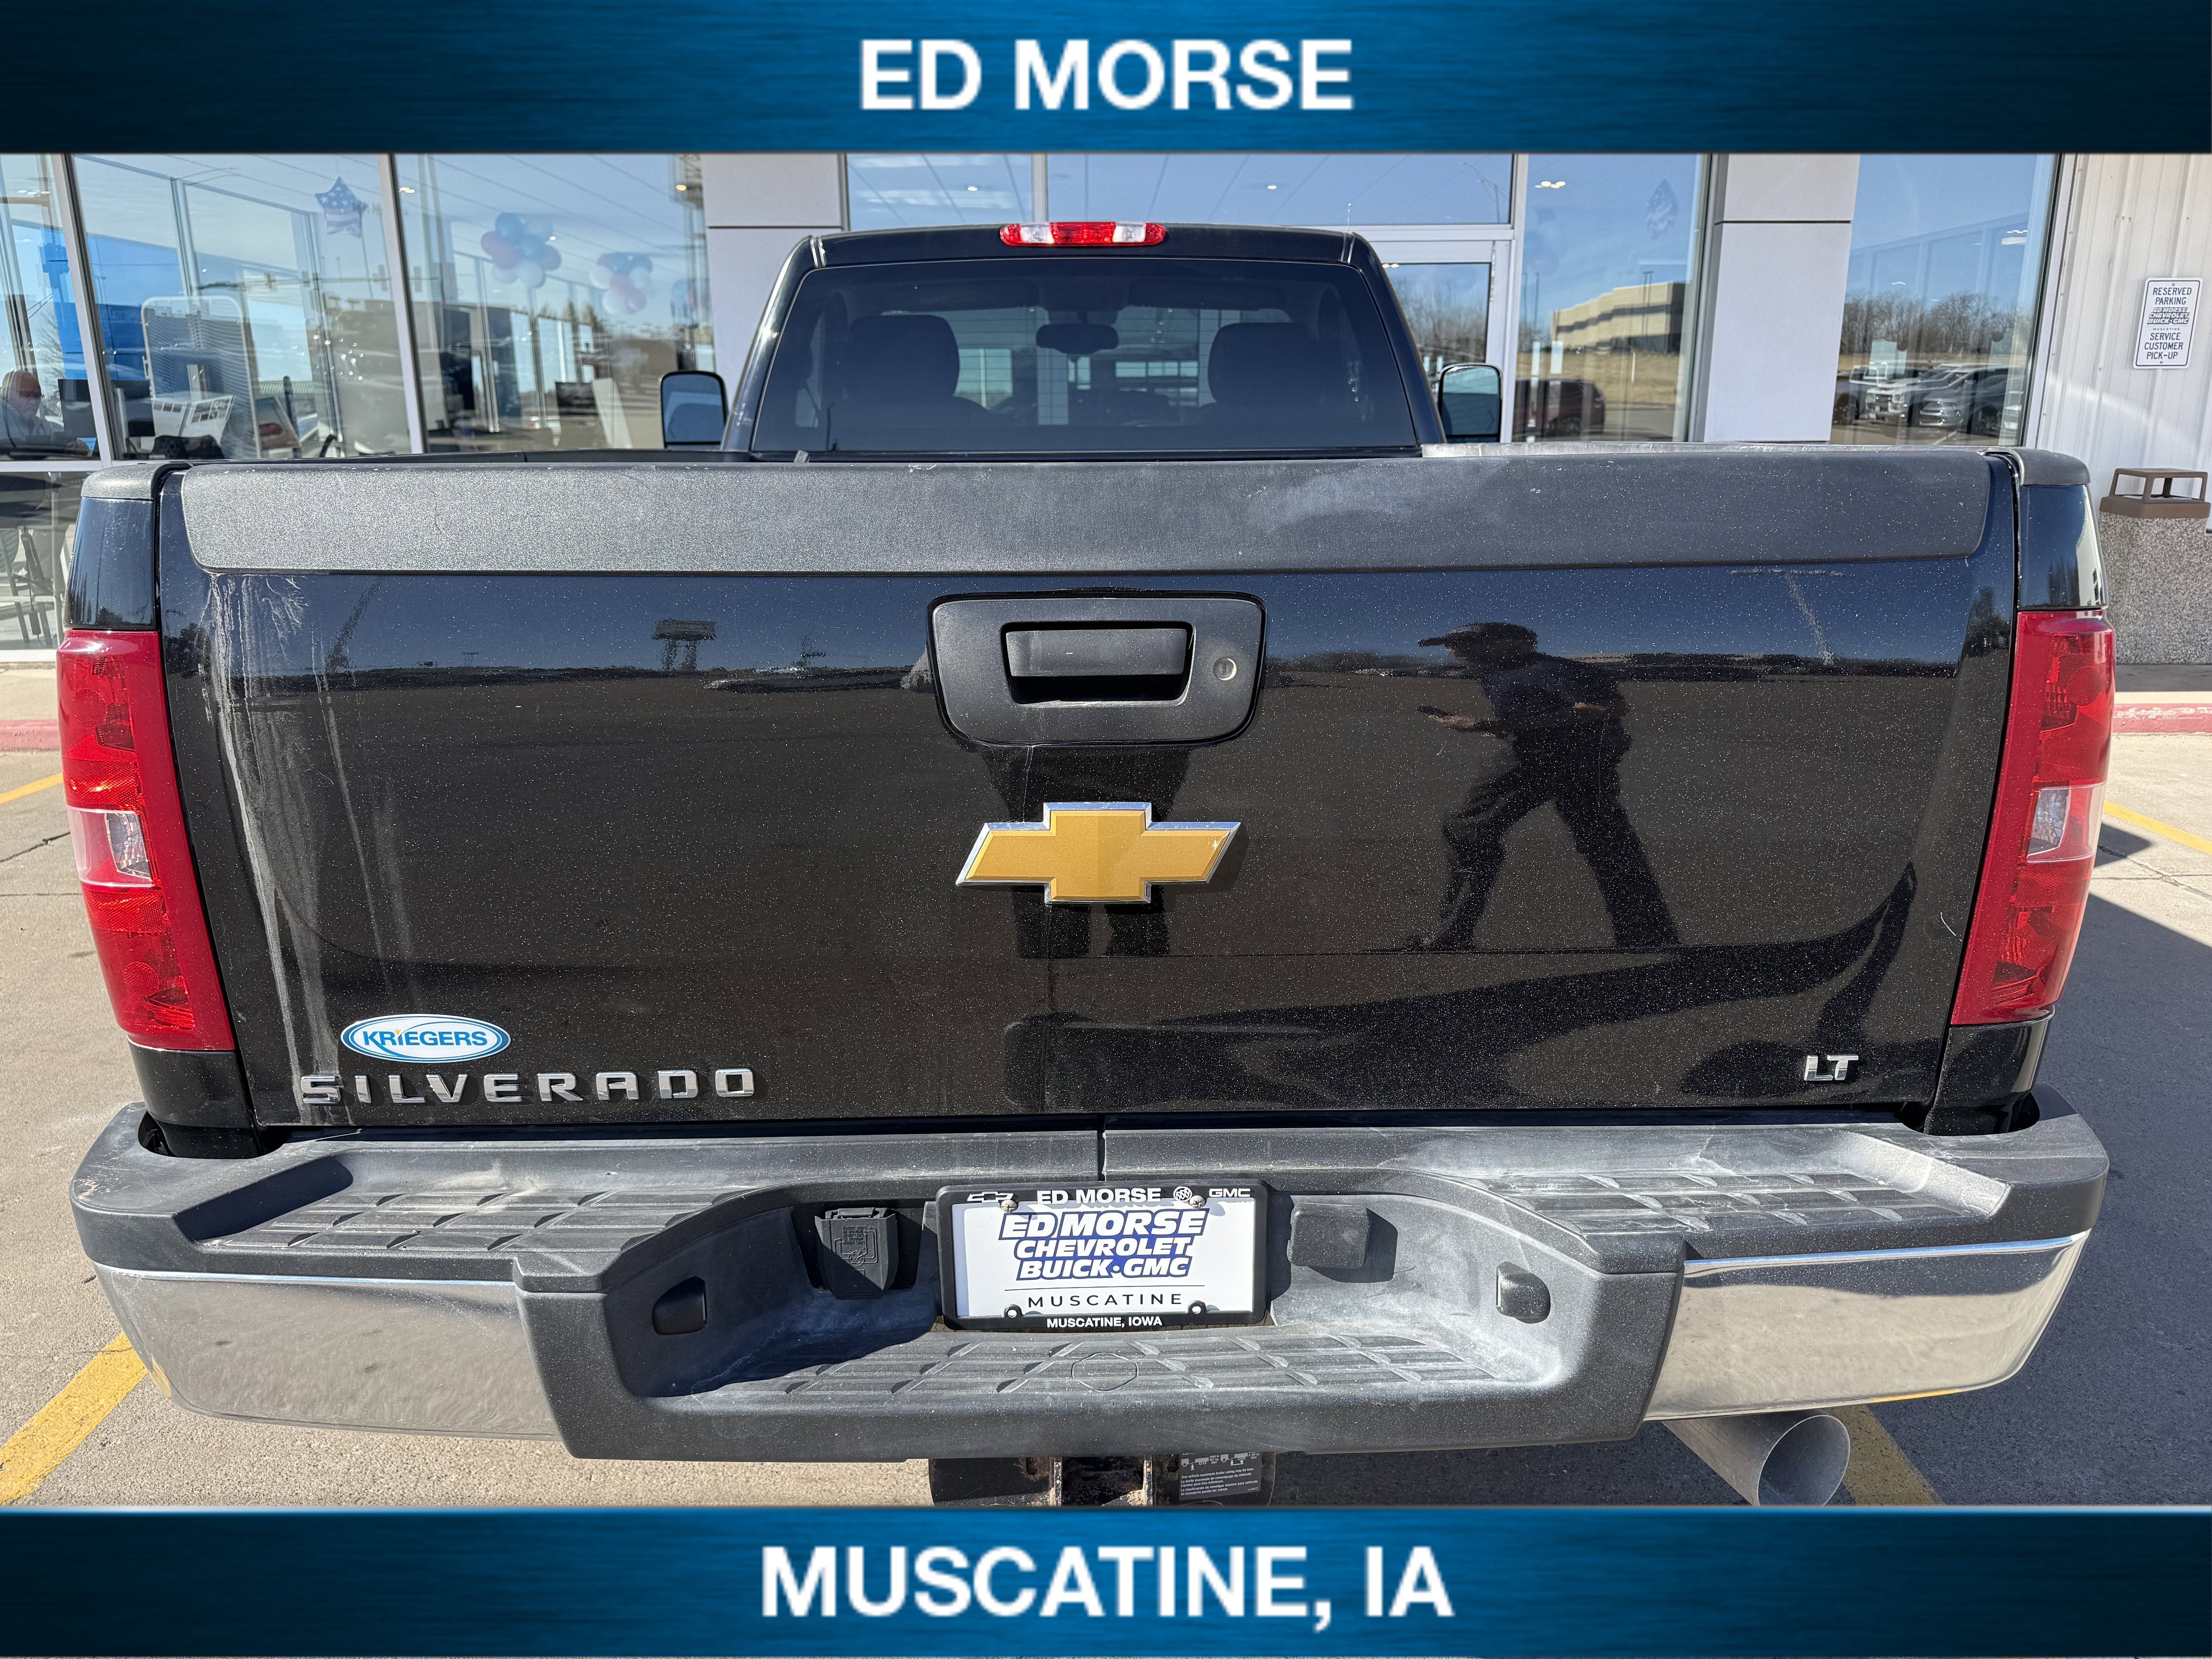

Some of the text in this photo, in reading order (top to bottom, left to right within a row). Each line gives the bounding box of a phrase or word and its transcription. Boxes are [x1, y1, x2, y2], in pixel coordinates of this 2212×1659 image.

[2150, 332, 2181, 340] SERVICE
[2144, 342, 2183, 350] CUSTOMER
[2147, 351, 2178, 359] PICK-UP
[1804, 1054, 1859, 1081] LT
[300, 1068, 756, 1104] SILVERADO
[1037, 1188, 1161, 1205] ED MORSE
[1209, 1187, 1251, 1198] GMC
[1000, 1209, 1208, 1239] ED MORSE
[1015, 1238, 1193, 1259] CHEVROLET
[1029, 1293, 1182, 1308] MUSCATINE
[1047, 1316, 1163, 1329] MUSCATINE, IOWA
